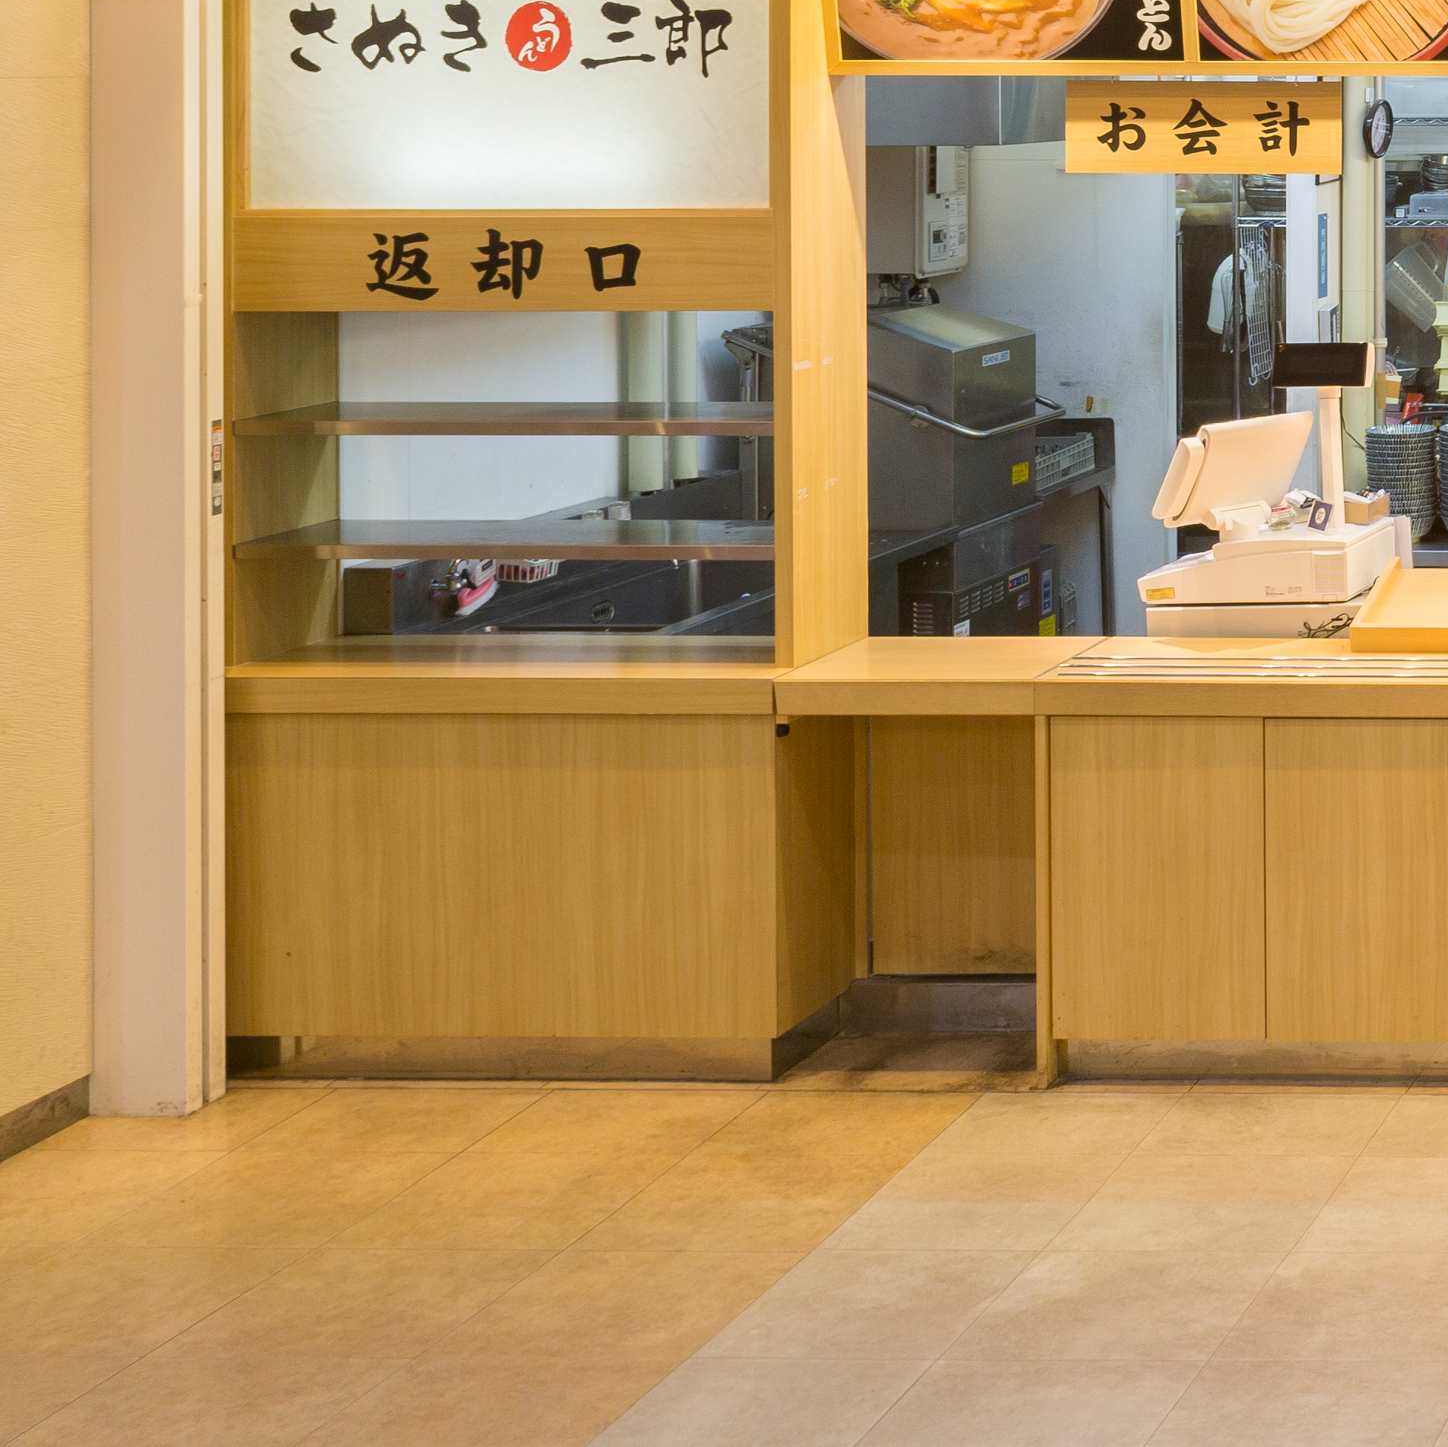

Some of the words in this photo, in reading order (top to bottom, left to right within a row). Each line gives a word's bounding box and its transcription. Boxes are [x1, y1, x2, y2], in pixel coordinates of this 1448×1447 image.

[1097, 98, 1310, 157] お会計
[366, 228, 642, 300] 返却口
